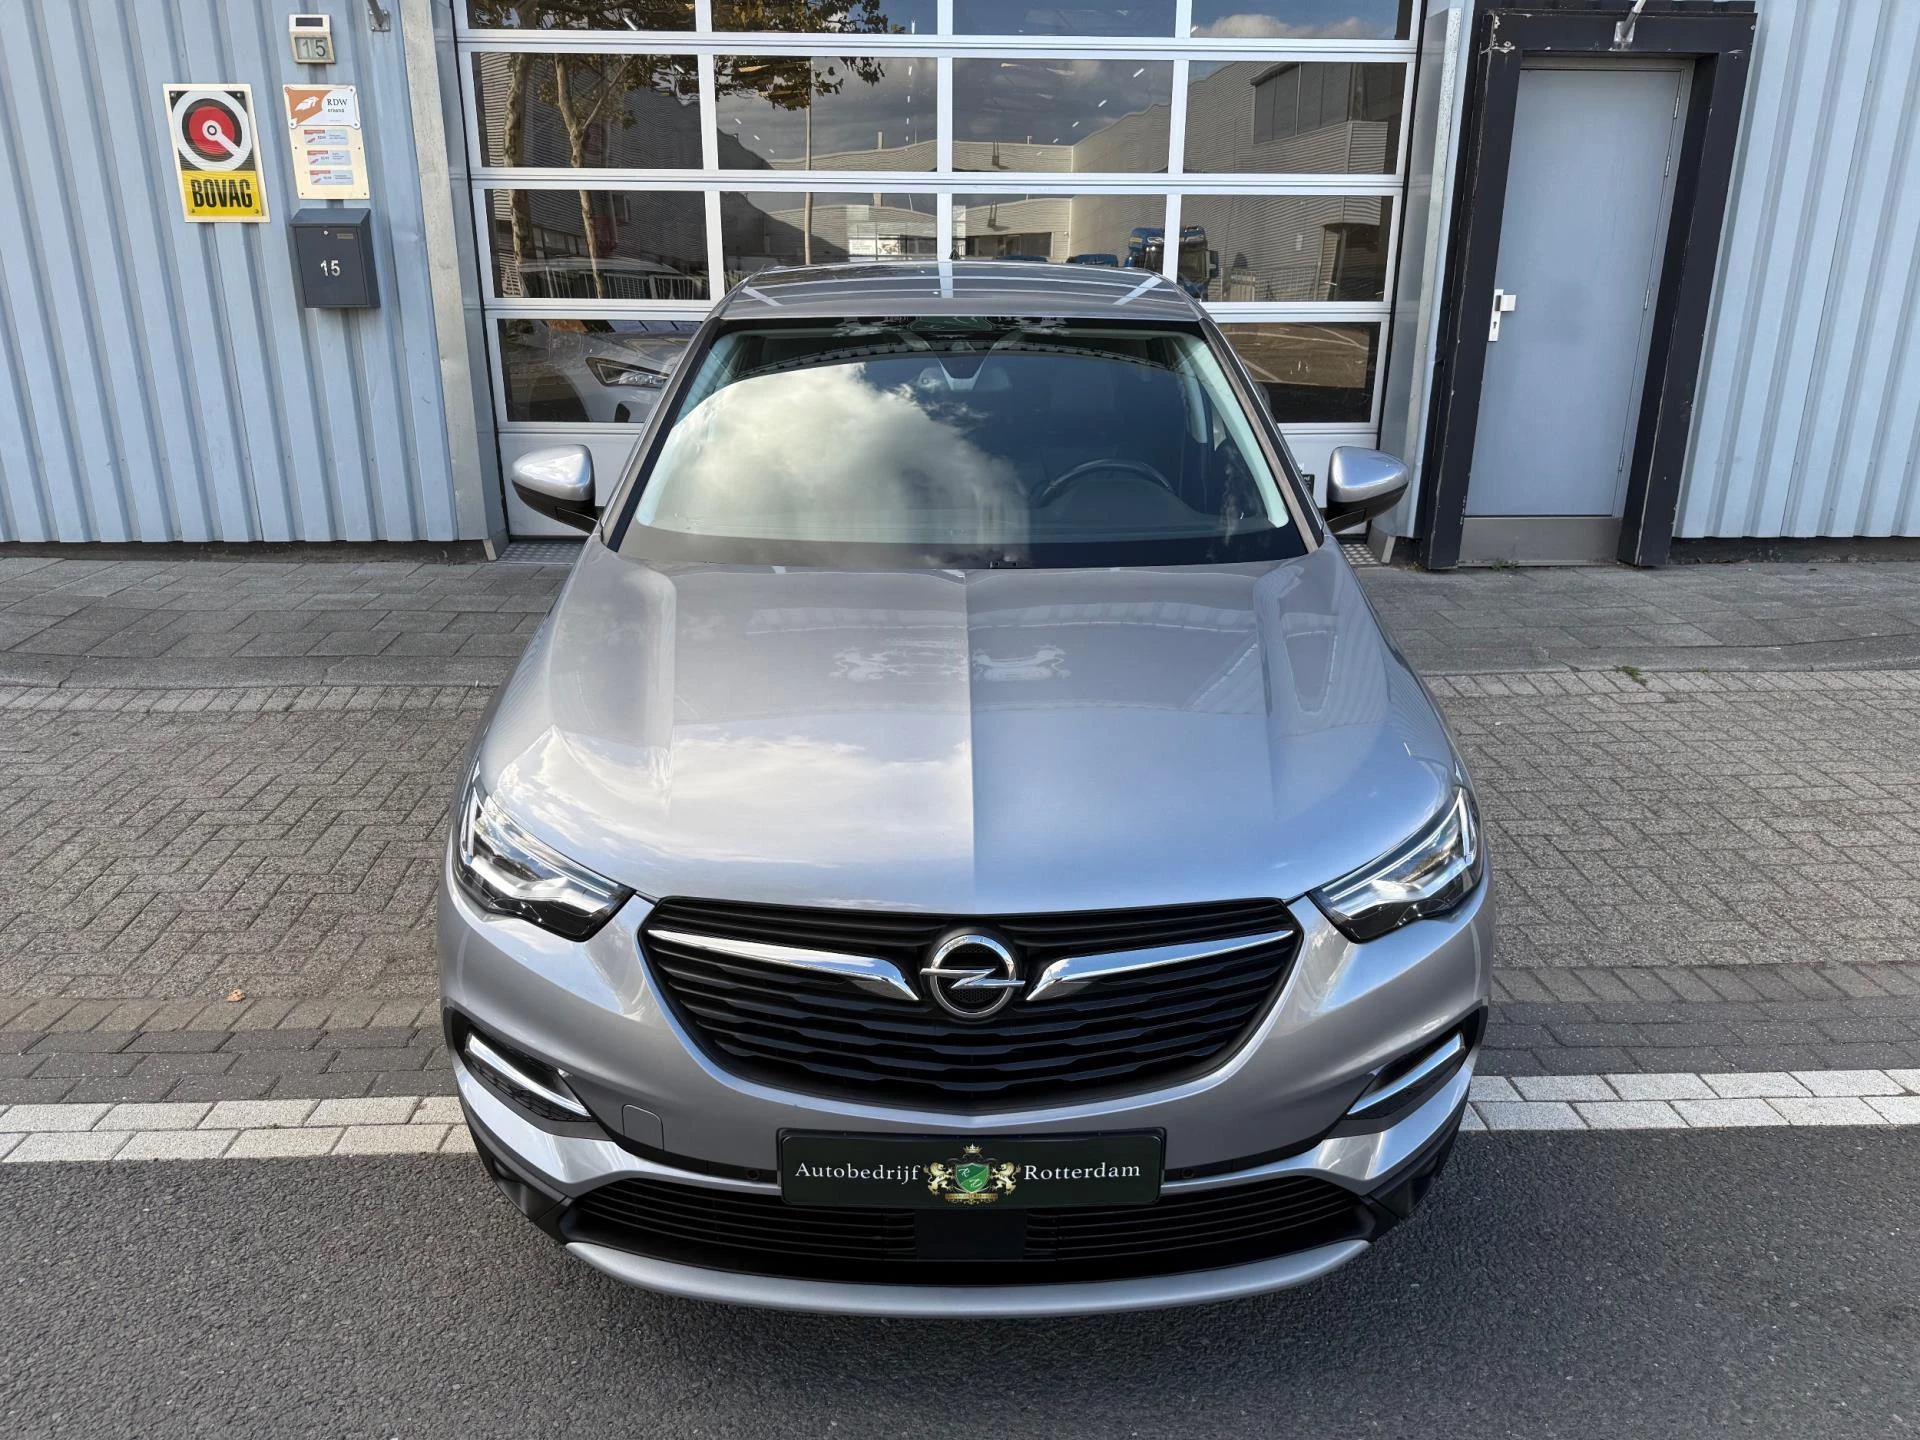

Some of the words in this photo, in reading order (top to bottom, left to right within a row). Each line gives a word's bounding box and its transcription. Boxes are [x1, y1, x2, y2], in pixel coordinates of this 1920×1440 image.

[303, 39, 326, 58] 15
[327, 98, 348, 106] RDW
[190, 178, 253, 208] BOVAG
[320, 259, 340, 277] 15
[795, 1163, 921, 1182] Autobedrijf
[1023, 1162, 1141, 1181] Rotterdam
